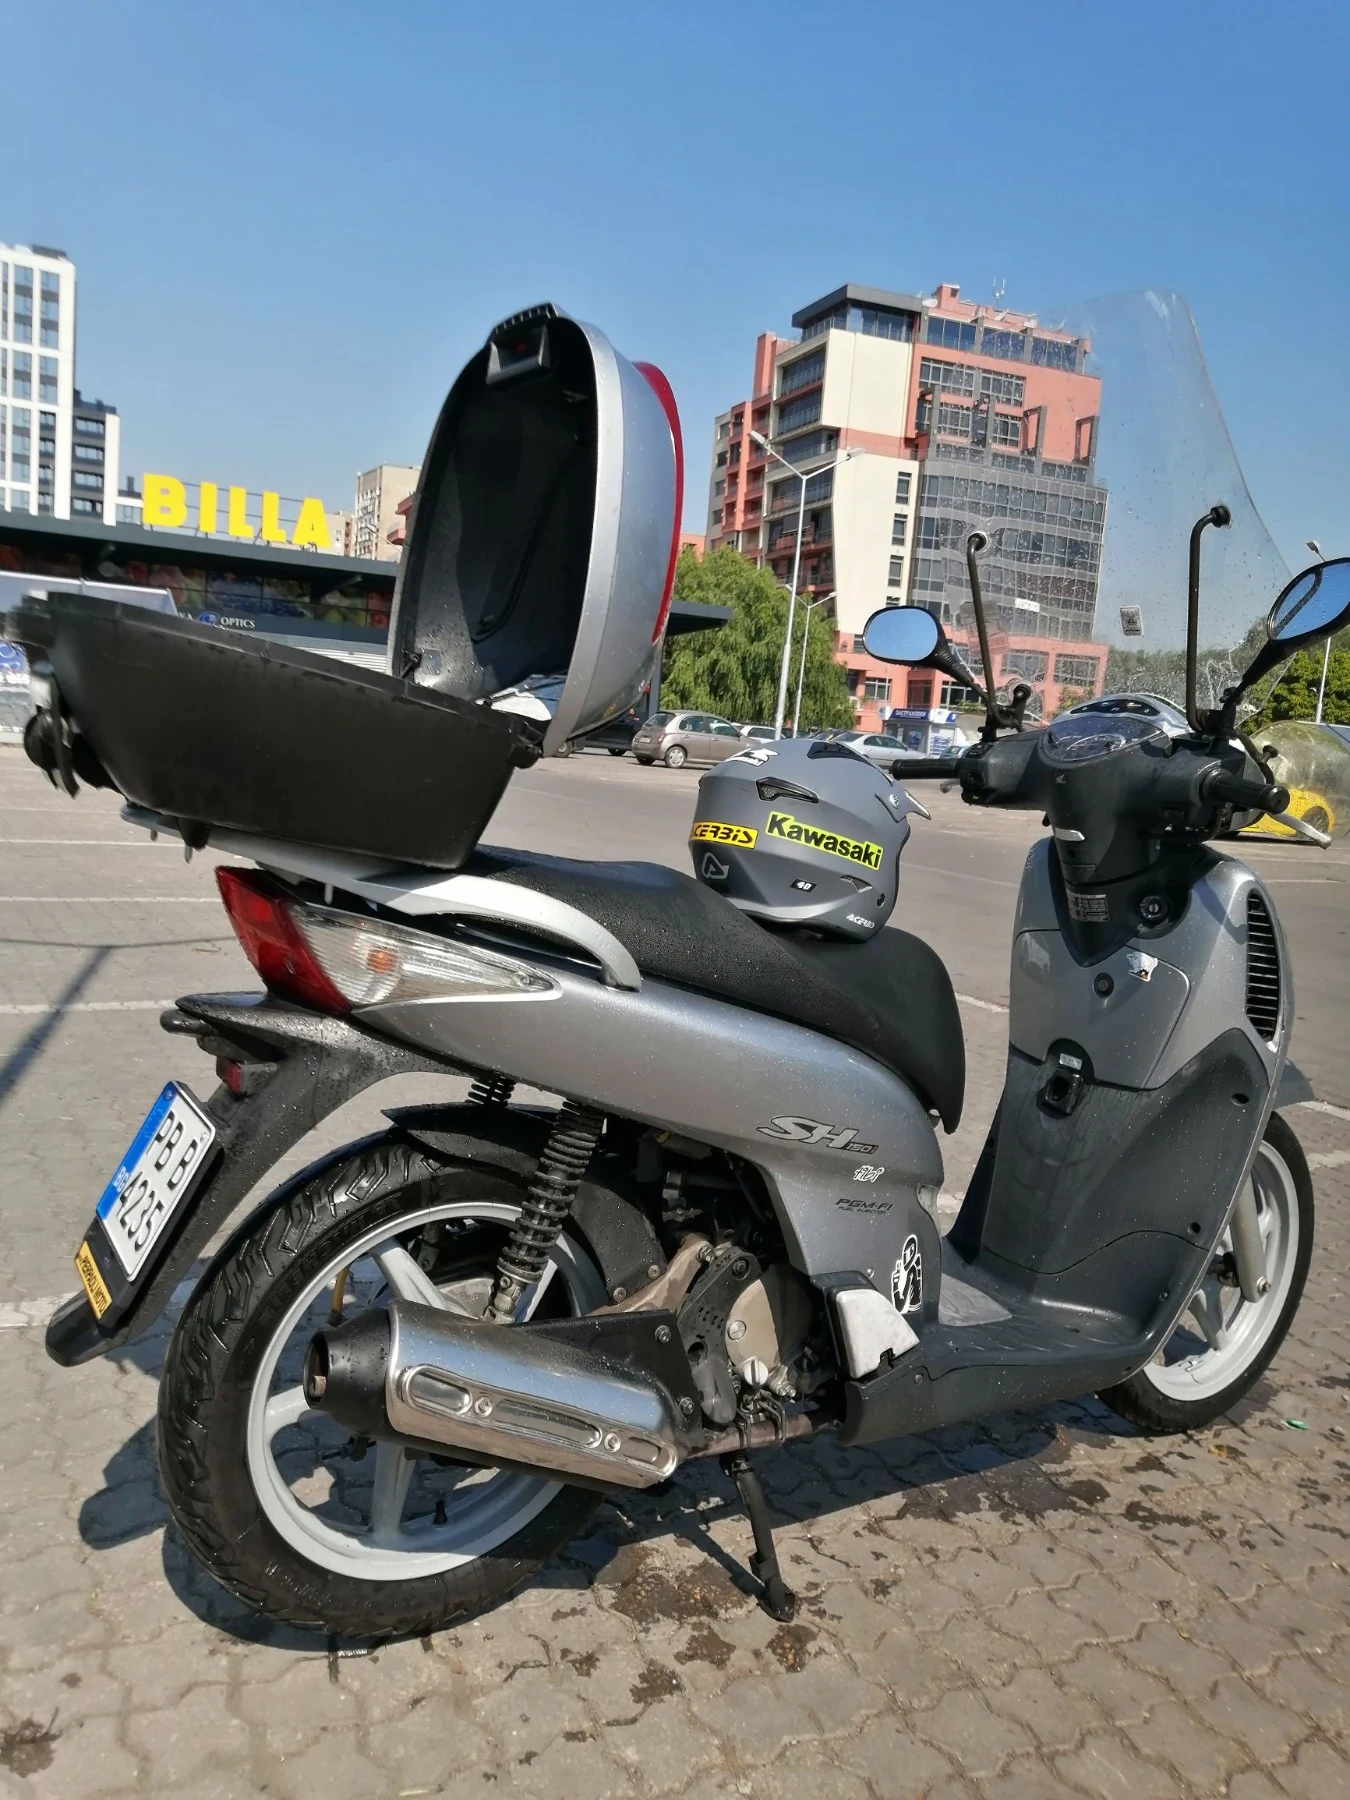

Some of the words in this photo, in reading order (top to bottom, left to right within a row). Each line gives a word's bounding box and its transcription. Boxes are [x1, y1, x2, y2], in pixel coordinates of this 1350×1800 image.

[143, 472, 332, 548] BILLA
[220, 616, 255, 629] OPTICS
[768, 813, 881, 869] Kawasaki
[796, 881, 812, 891] 40
[146, 1110, 185, 1173] PB
[166, 1138, 199, 1191] B
[756, 1115, 859, 1149] SH
[113, 1166, 130, 1193] BG
[116, 1171, 165, 1252] 4235
